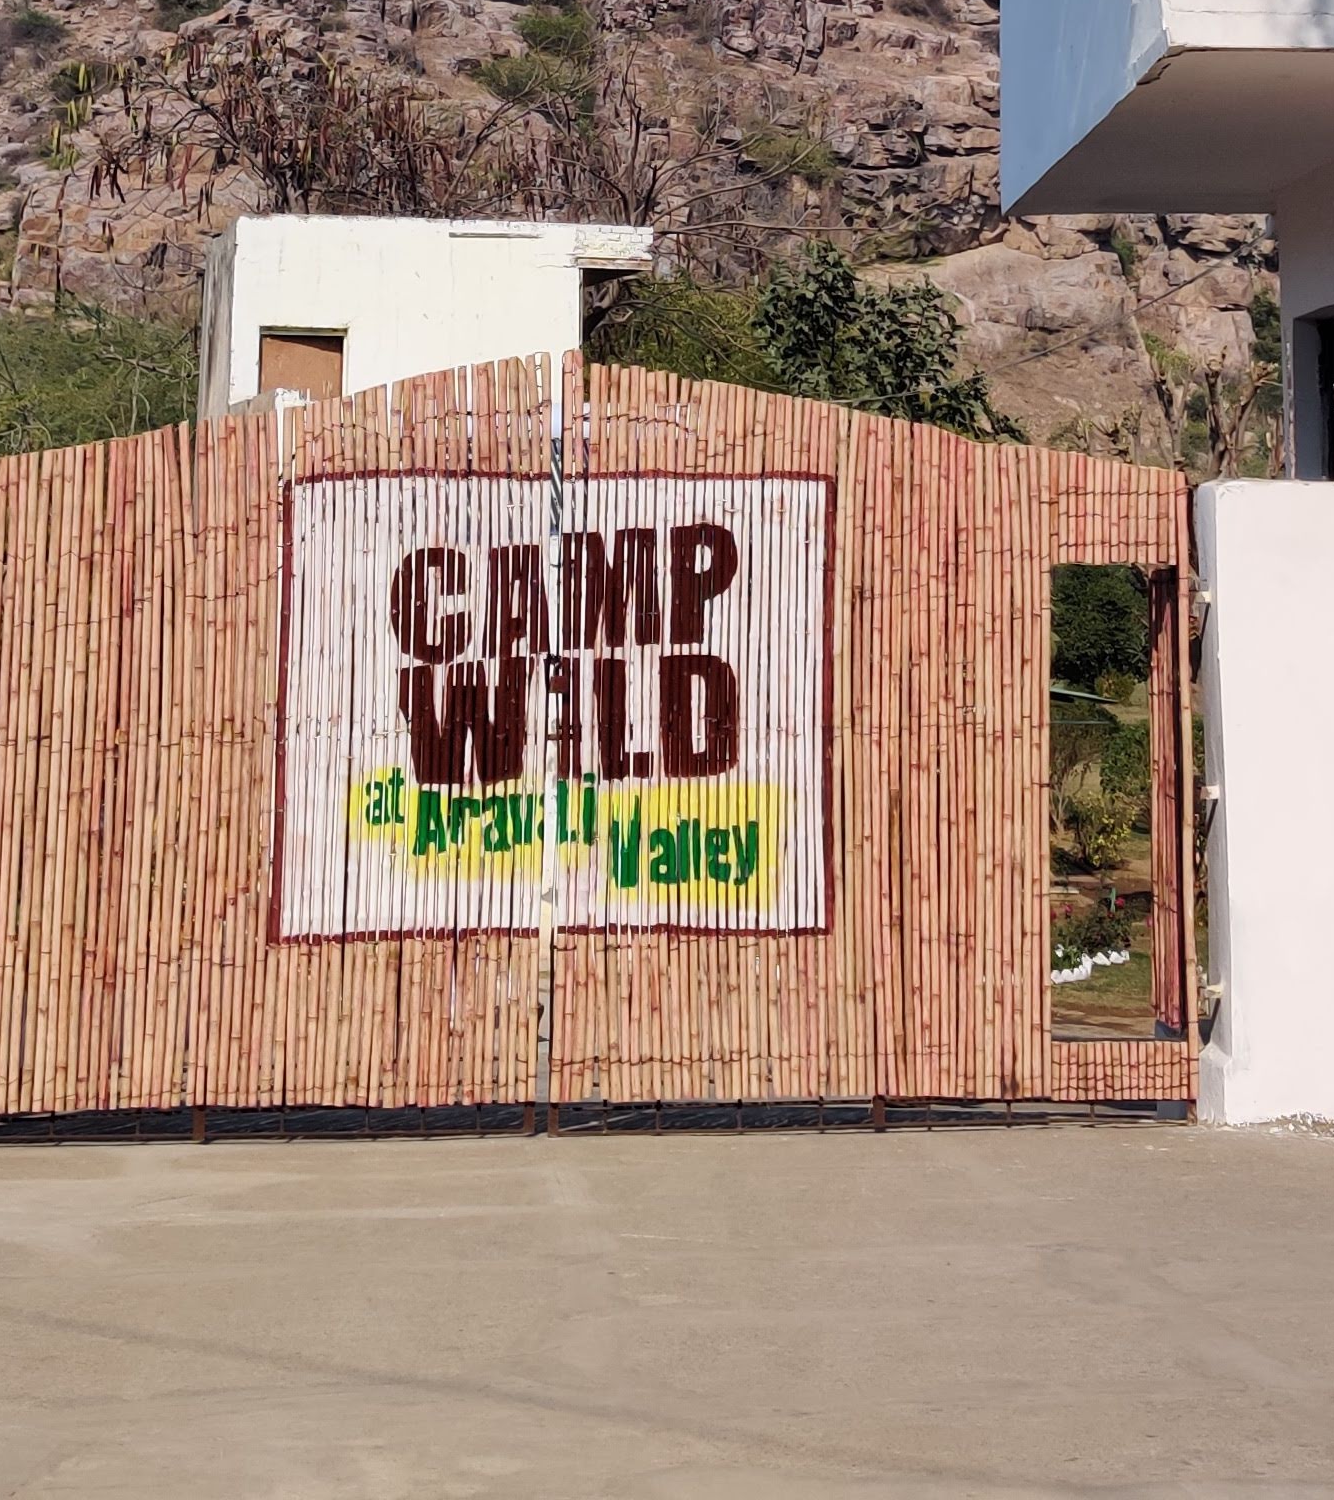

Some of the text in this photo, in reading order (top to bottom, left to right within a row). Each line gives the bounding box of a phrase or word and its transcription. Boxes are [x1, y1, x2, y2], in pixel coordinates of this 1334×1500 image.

[390, 522, 739, 664] CAMP
[398, 654, 740, 786] WILD
[365, 766, 405, 825] at
[611, 794, 759, 888] Valley
